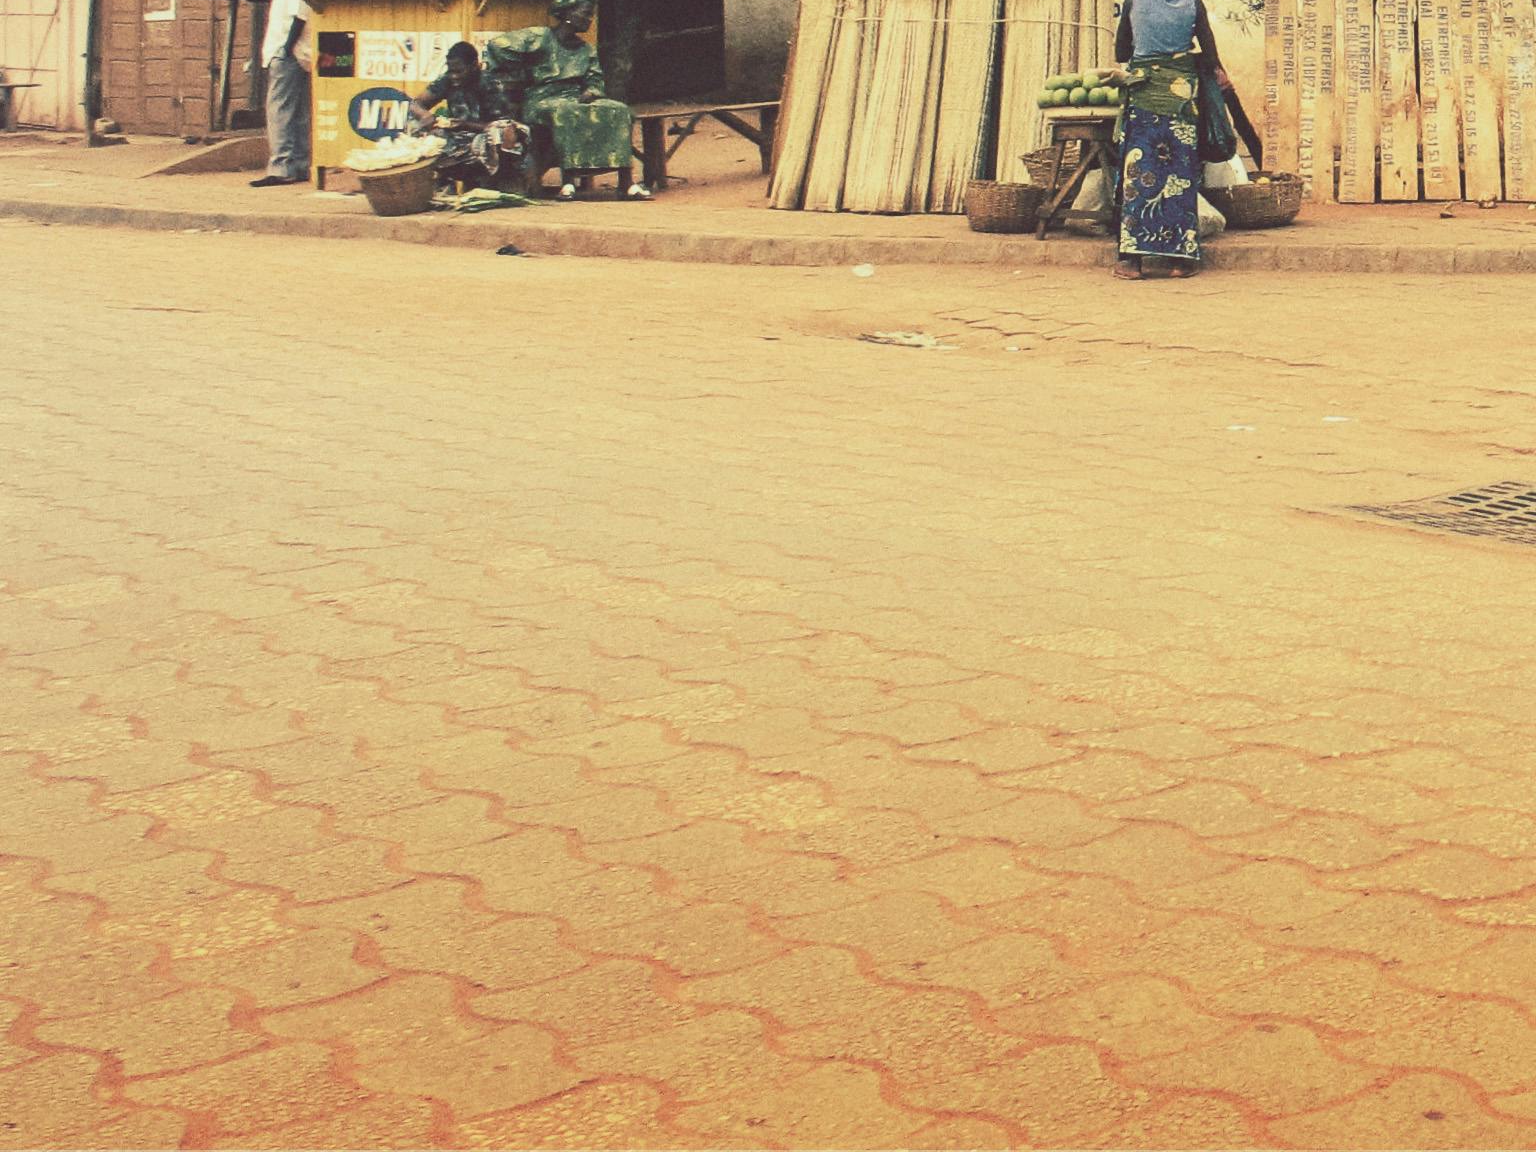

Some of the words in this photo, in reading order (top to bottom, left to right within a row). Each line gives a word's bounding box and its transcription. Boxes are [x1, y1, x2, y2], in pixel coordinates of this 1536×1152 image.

[1282, 16, 1295, 87] ENTREPRISE
[1321, 24, 1333, 94] ENTREPRISE
[1359, 24, 1372, 94] ENTREPRISE
[1437, 6, 1451, 75] ENTREPRISE
[1477, 0, 1490, 69] ENTREPRISE
[357, 99, 410, 130] MTN
